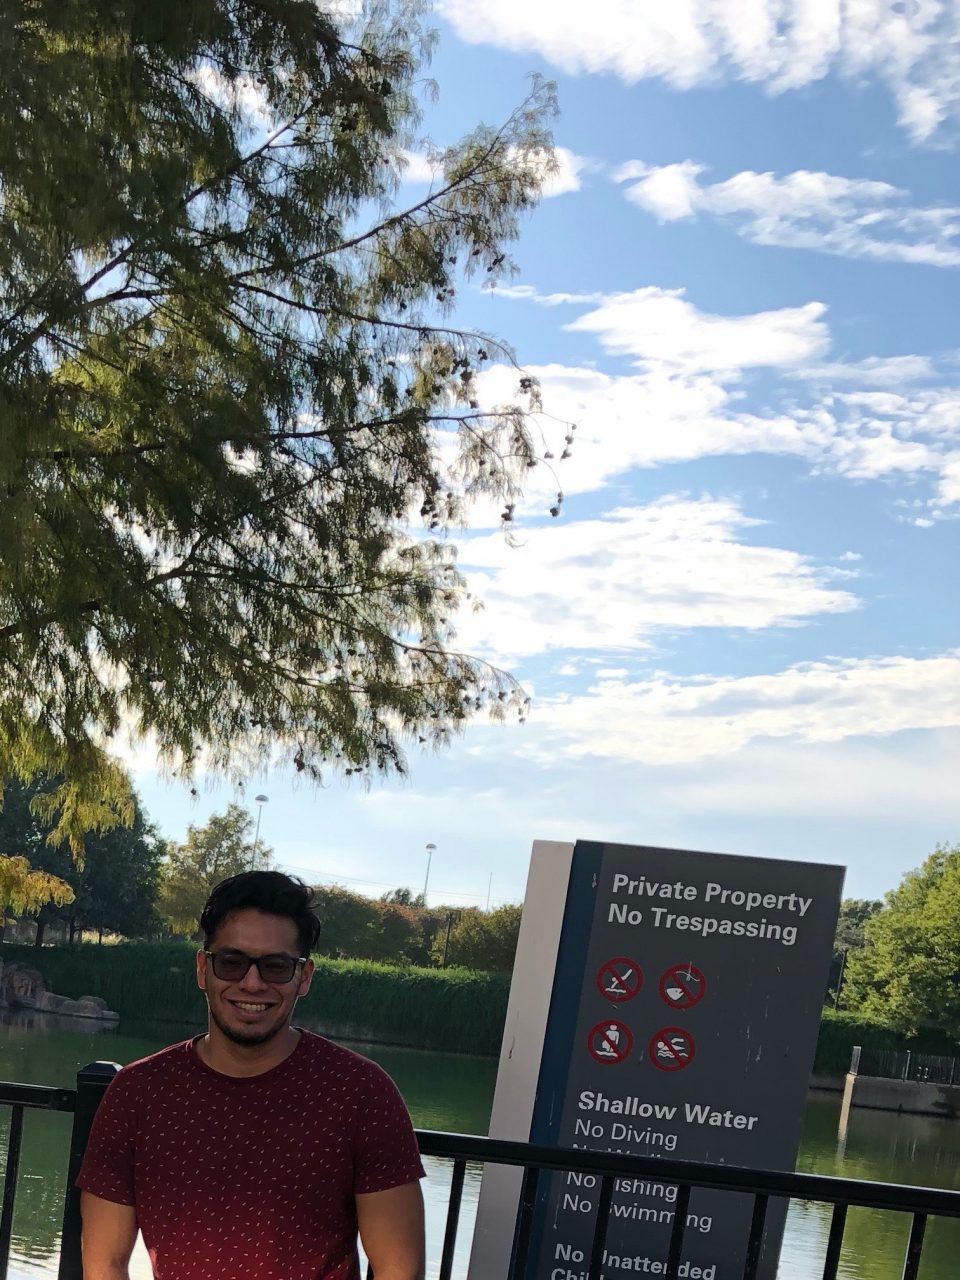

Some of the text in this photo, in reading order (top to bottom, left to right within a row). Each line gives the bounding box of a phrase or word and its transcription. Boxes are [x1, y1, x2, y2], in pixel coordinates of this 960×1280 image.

[612, 873, 812, 916] Private Property
[608, 903, 797, 945] No Trespassing
[578, 1091, 758, 1130] Shallow Water
[575, 1118, 677, 1150] No Diving
[566, 1171, 678, 1203] No ishing
[563, 1193, 712, 1233] No wimmng
[555, 1243, 584, 1263] No
